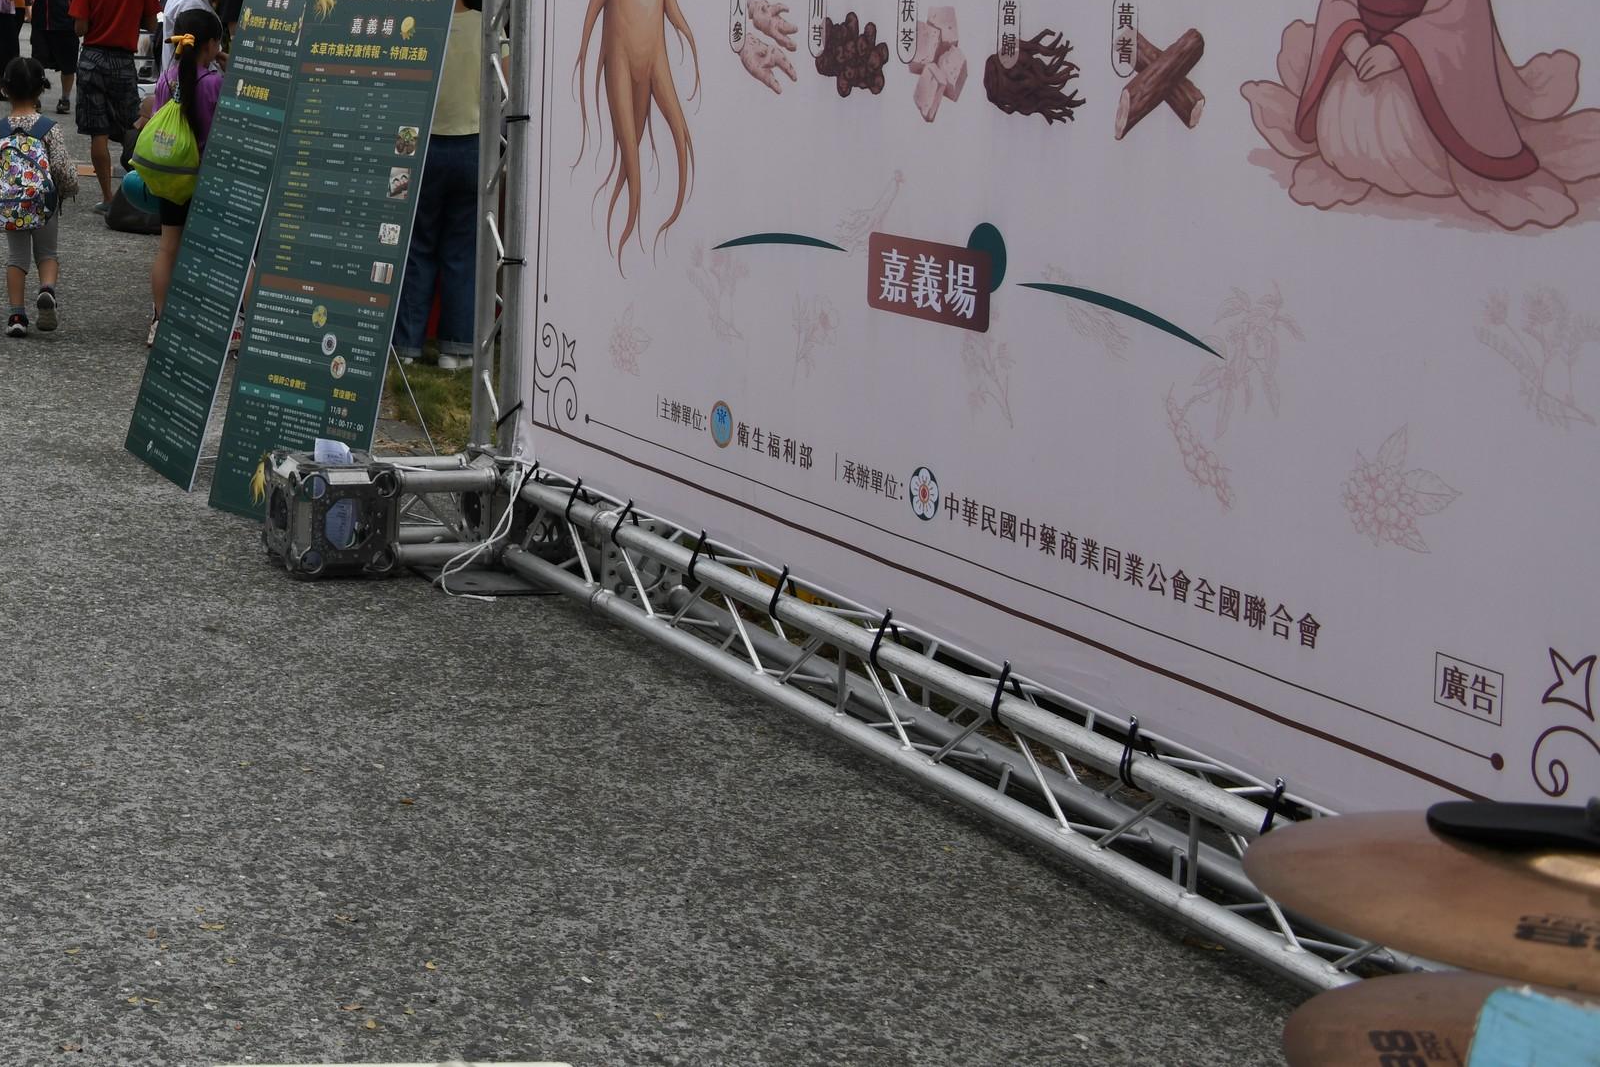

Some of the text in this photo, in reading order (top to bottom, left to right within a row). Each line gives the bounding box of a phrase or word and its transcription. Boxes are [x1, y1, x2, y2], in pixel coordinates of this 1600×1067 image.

[310, 42, 380, 60] 本草市集好康情報
[350, 17, 395, 36] 嘉義場
[1001, 0, 1019, 59] 當歸
[1115, 3, 1136, 65] 黃耆
[879, 247, 979, 320] 嘉義場
[736, 420, 814, 471] 衛生福利部
[943, 490, 1322, 650] 中華民國中藥商業同業公會全國聯合會
[1439, 665, 1499, 716] 廣告
